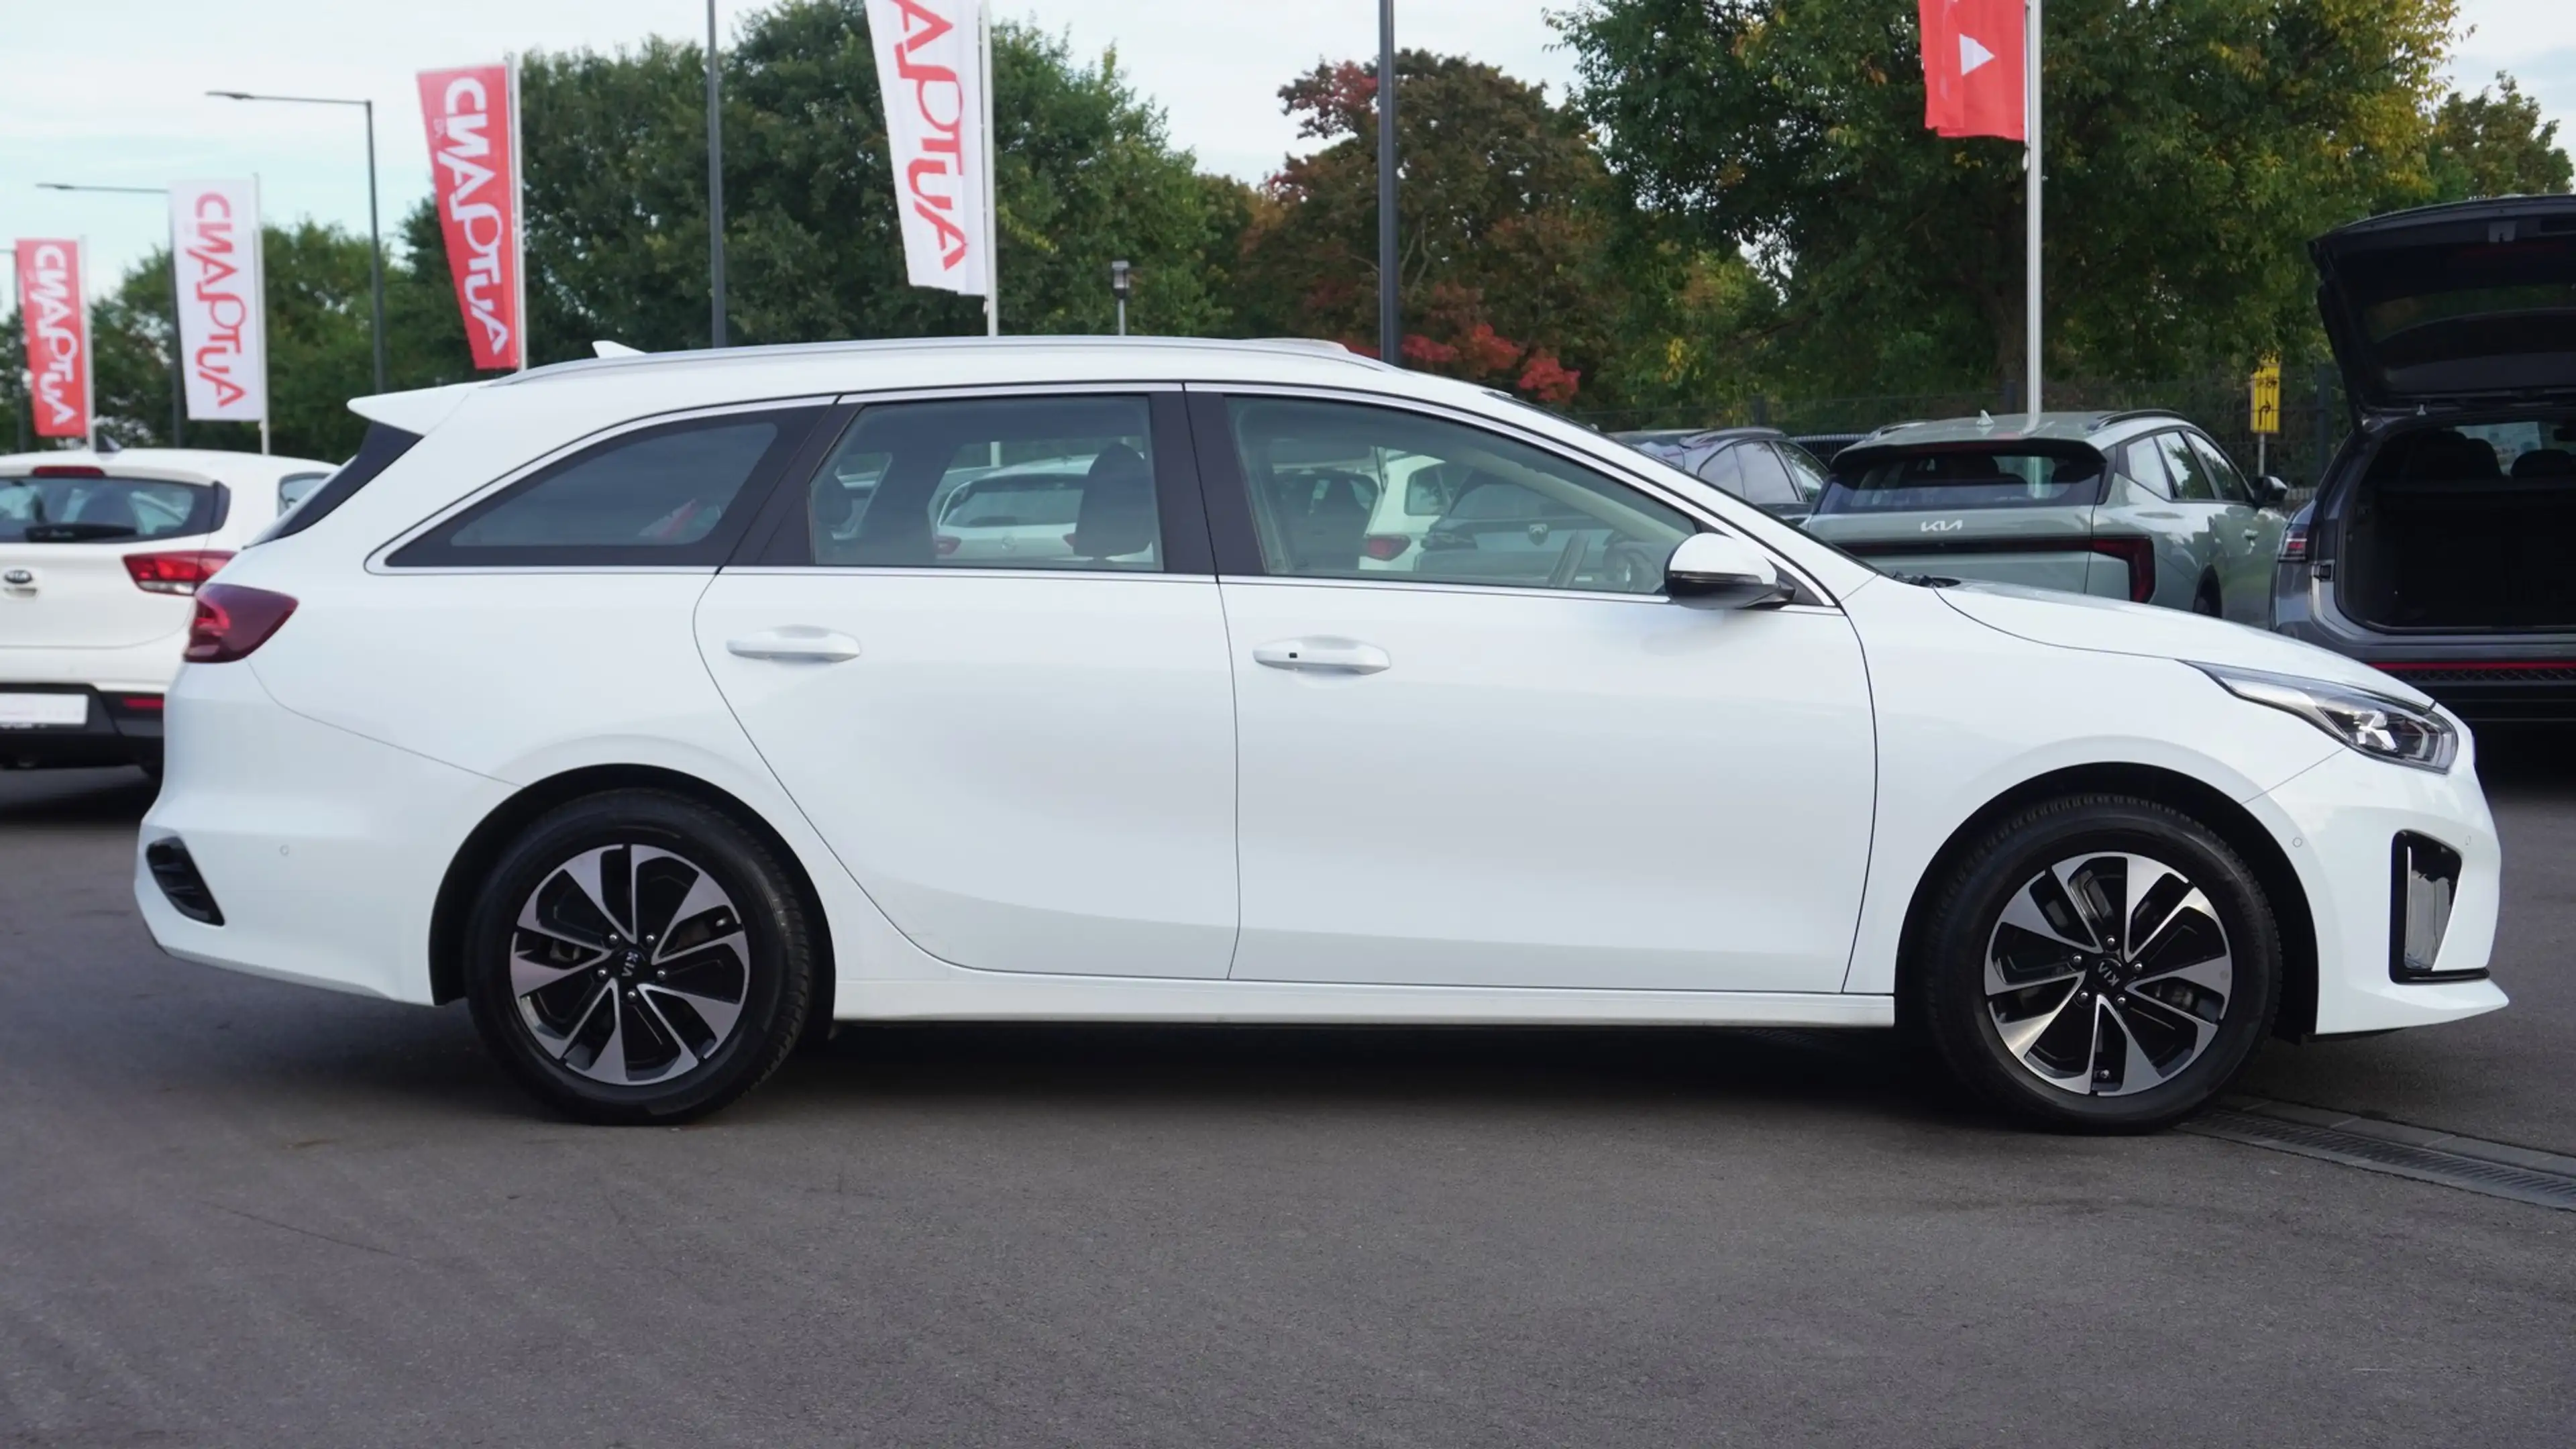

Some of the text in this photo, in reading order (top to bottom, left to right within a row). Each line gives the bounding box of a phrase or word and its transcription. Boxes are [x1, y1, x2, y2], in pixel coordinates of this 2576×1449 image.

[1920, 519, 1964, 532] KIA
[621, 951, 639, 977] KIA
[2098, 961, 2120, 987] KIA
